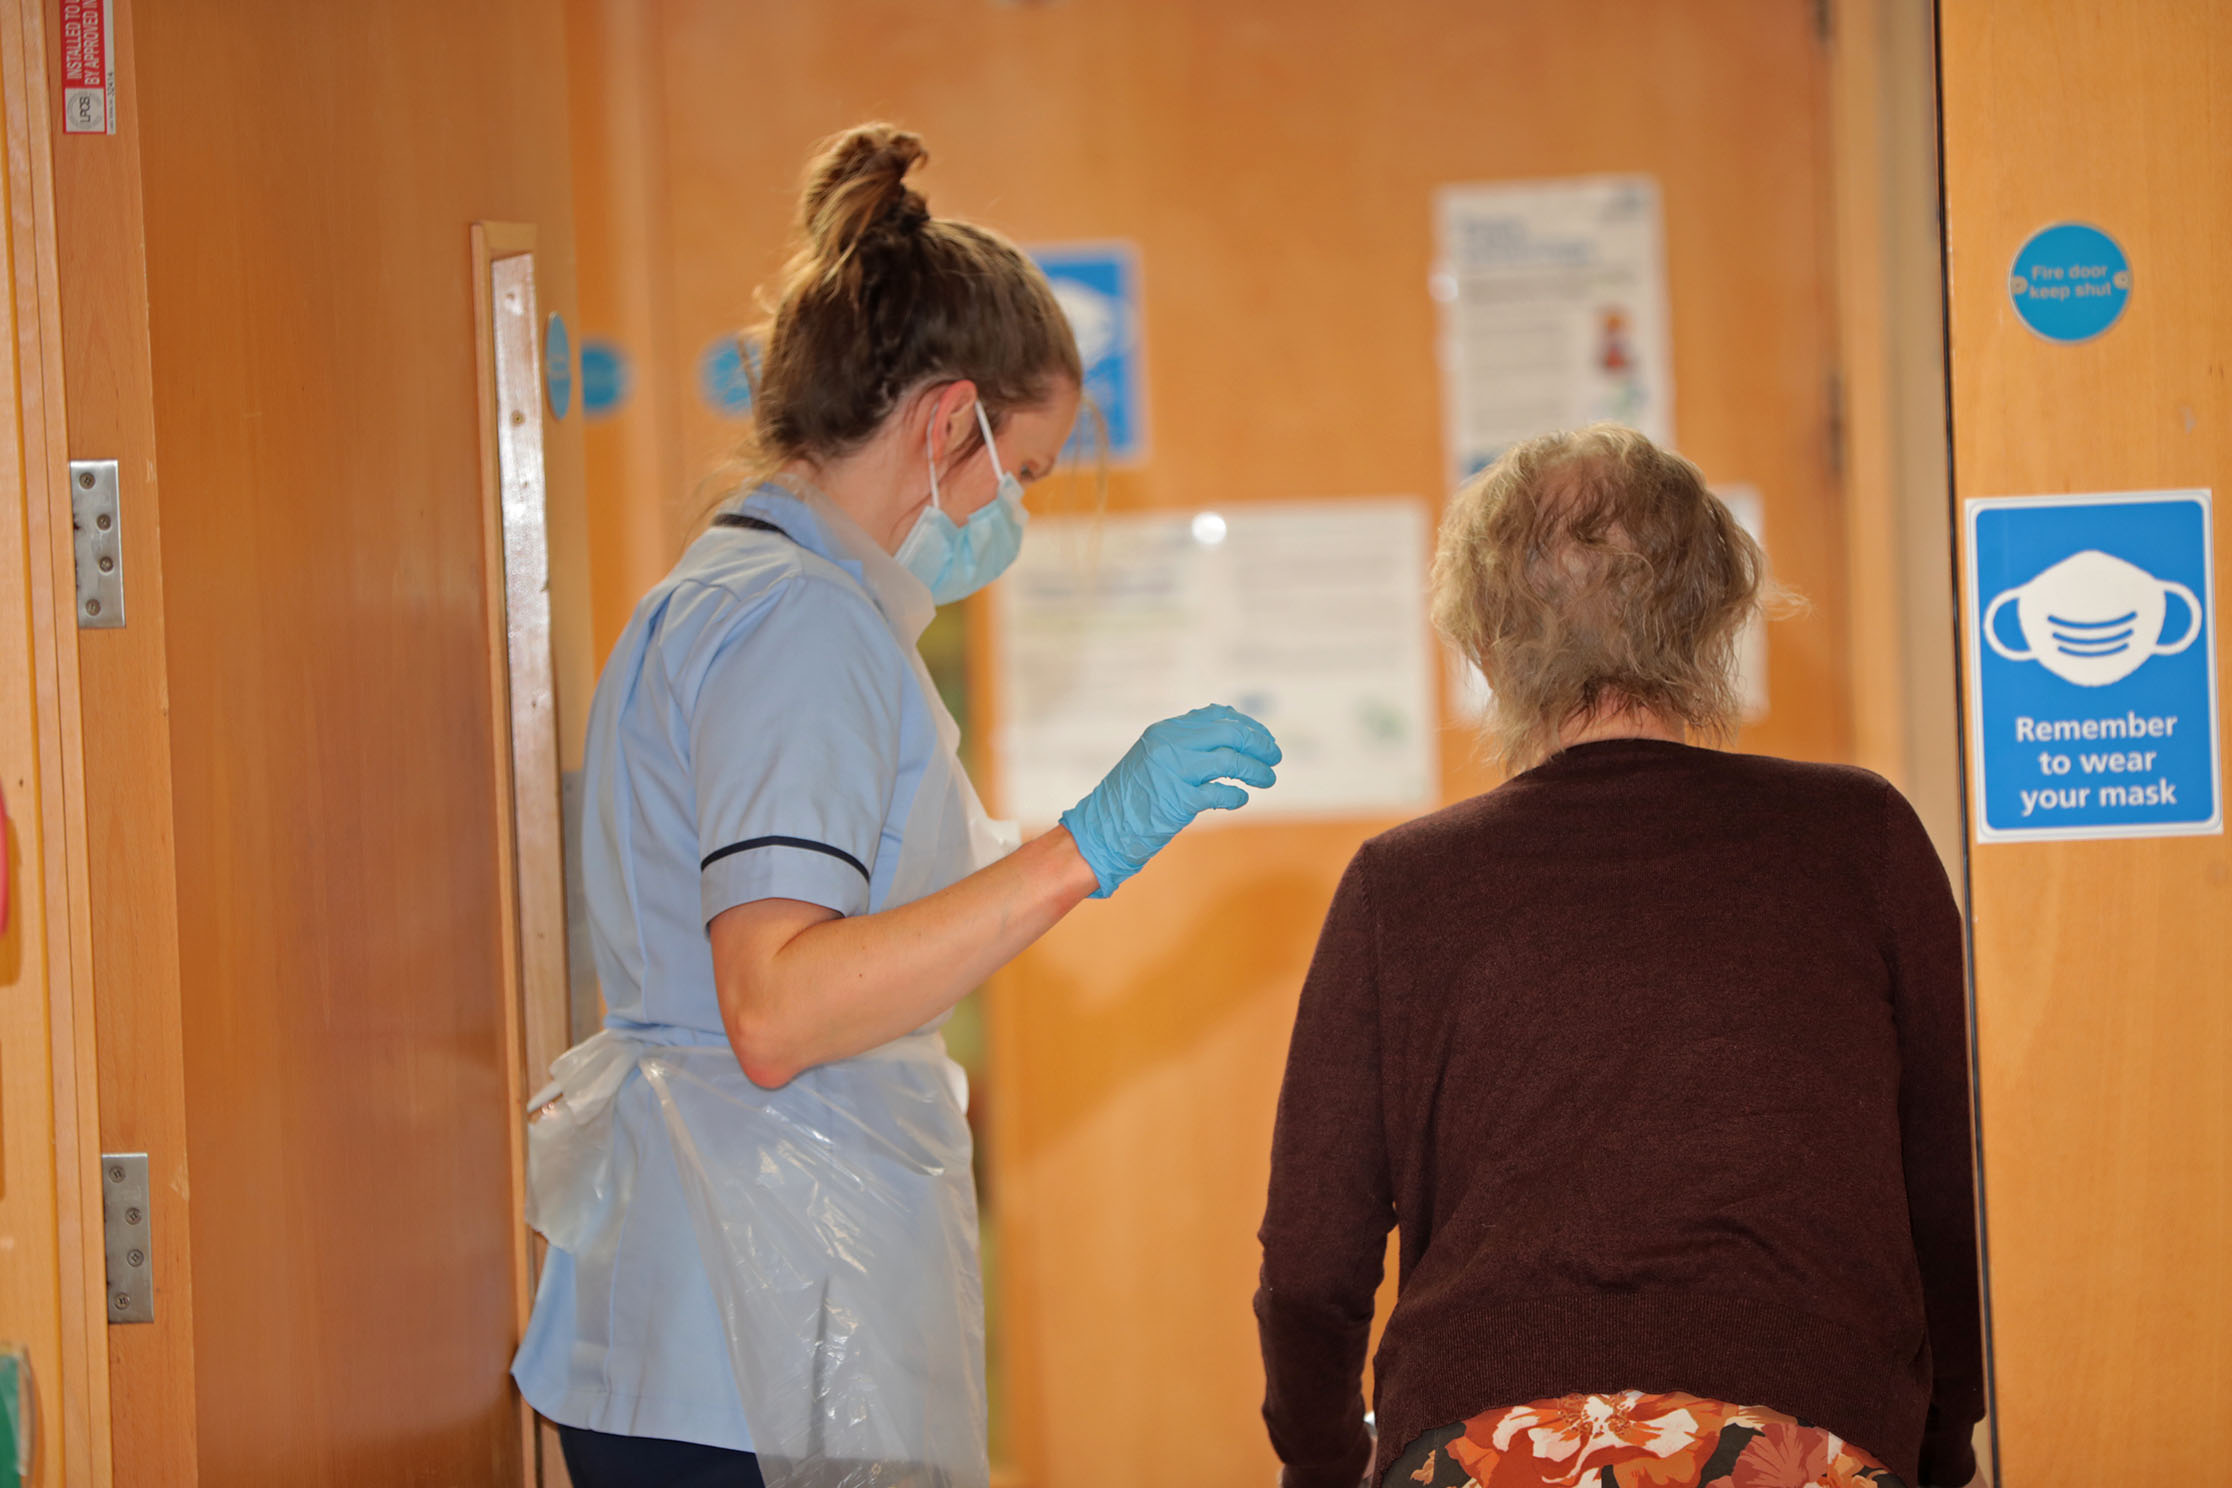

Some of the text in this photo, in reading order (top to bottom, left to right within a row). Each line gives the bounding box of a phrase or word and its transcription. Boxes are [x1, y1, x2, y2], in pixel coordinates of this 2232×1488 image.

[65, 4, 80, 20] TO
[66, 22, 82, 79] INSTALLED
[82, 11, 99, 69] APPROVED
[84, 70, 100, 85] BY
[2032, 264, 2109, 280] Fire door
[2029, 282, 2111, 302] keep shut
[2015, 711, 2178, 742] Remember
[2038, 750, 2157, 775] to wear
[2020, 777, 2177, 817] your mask
